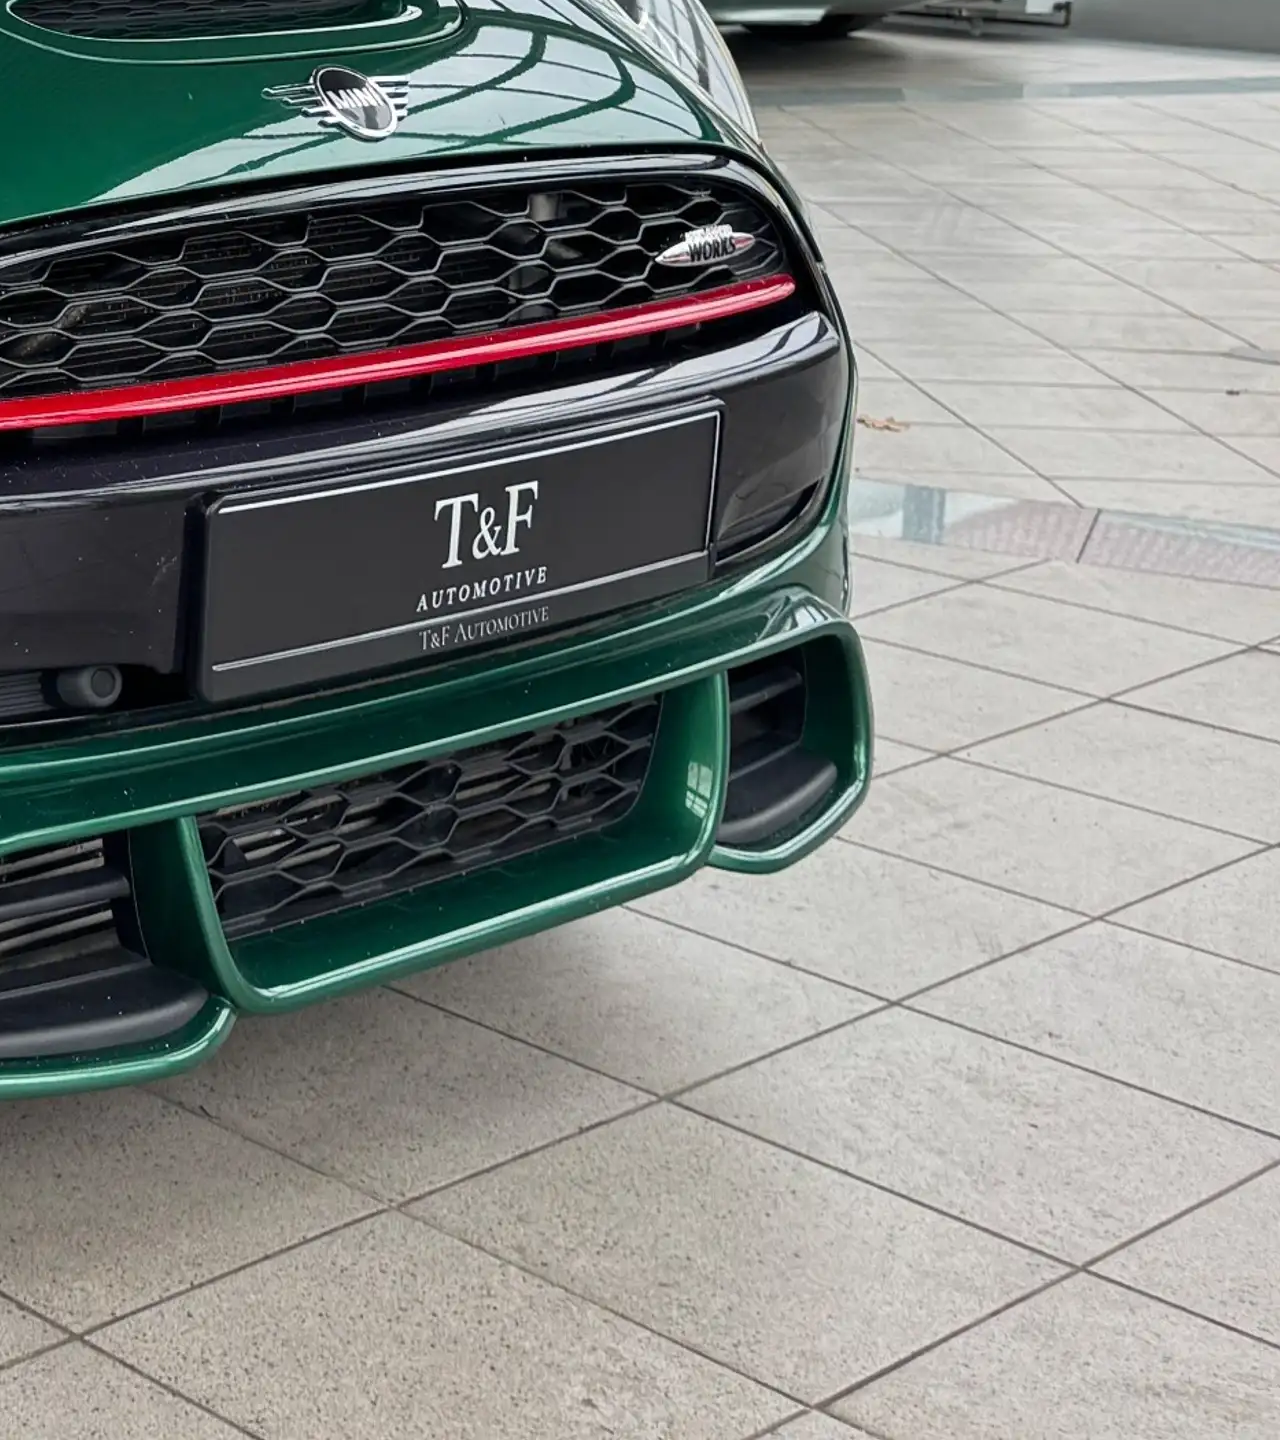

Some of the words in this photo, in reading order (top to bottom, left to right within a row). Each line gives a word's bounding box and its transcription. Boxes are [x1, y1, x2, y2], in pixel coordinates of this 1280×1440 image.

[325, 81, 385, 109] MINI
[688, 237, 736, 262] WORKS
[434, 480, 539, 569] T&F
[416, 566, 548, 612] AUTOMOTIVE
[419, 625, 451, 650] T&F
[454, 606, 549, 643] AUTOMOTIVE
